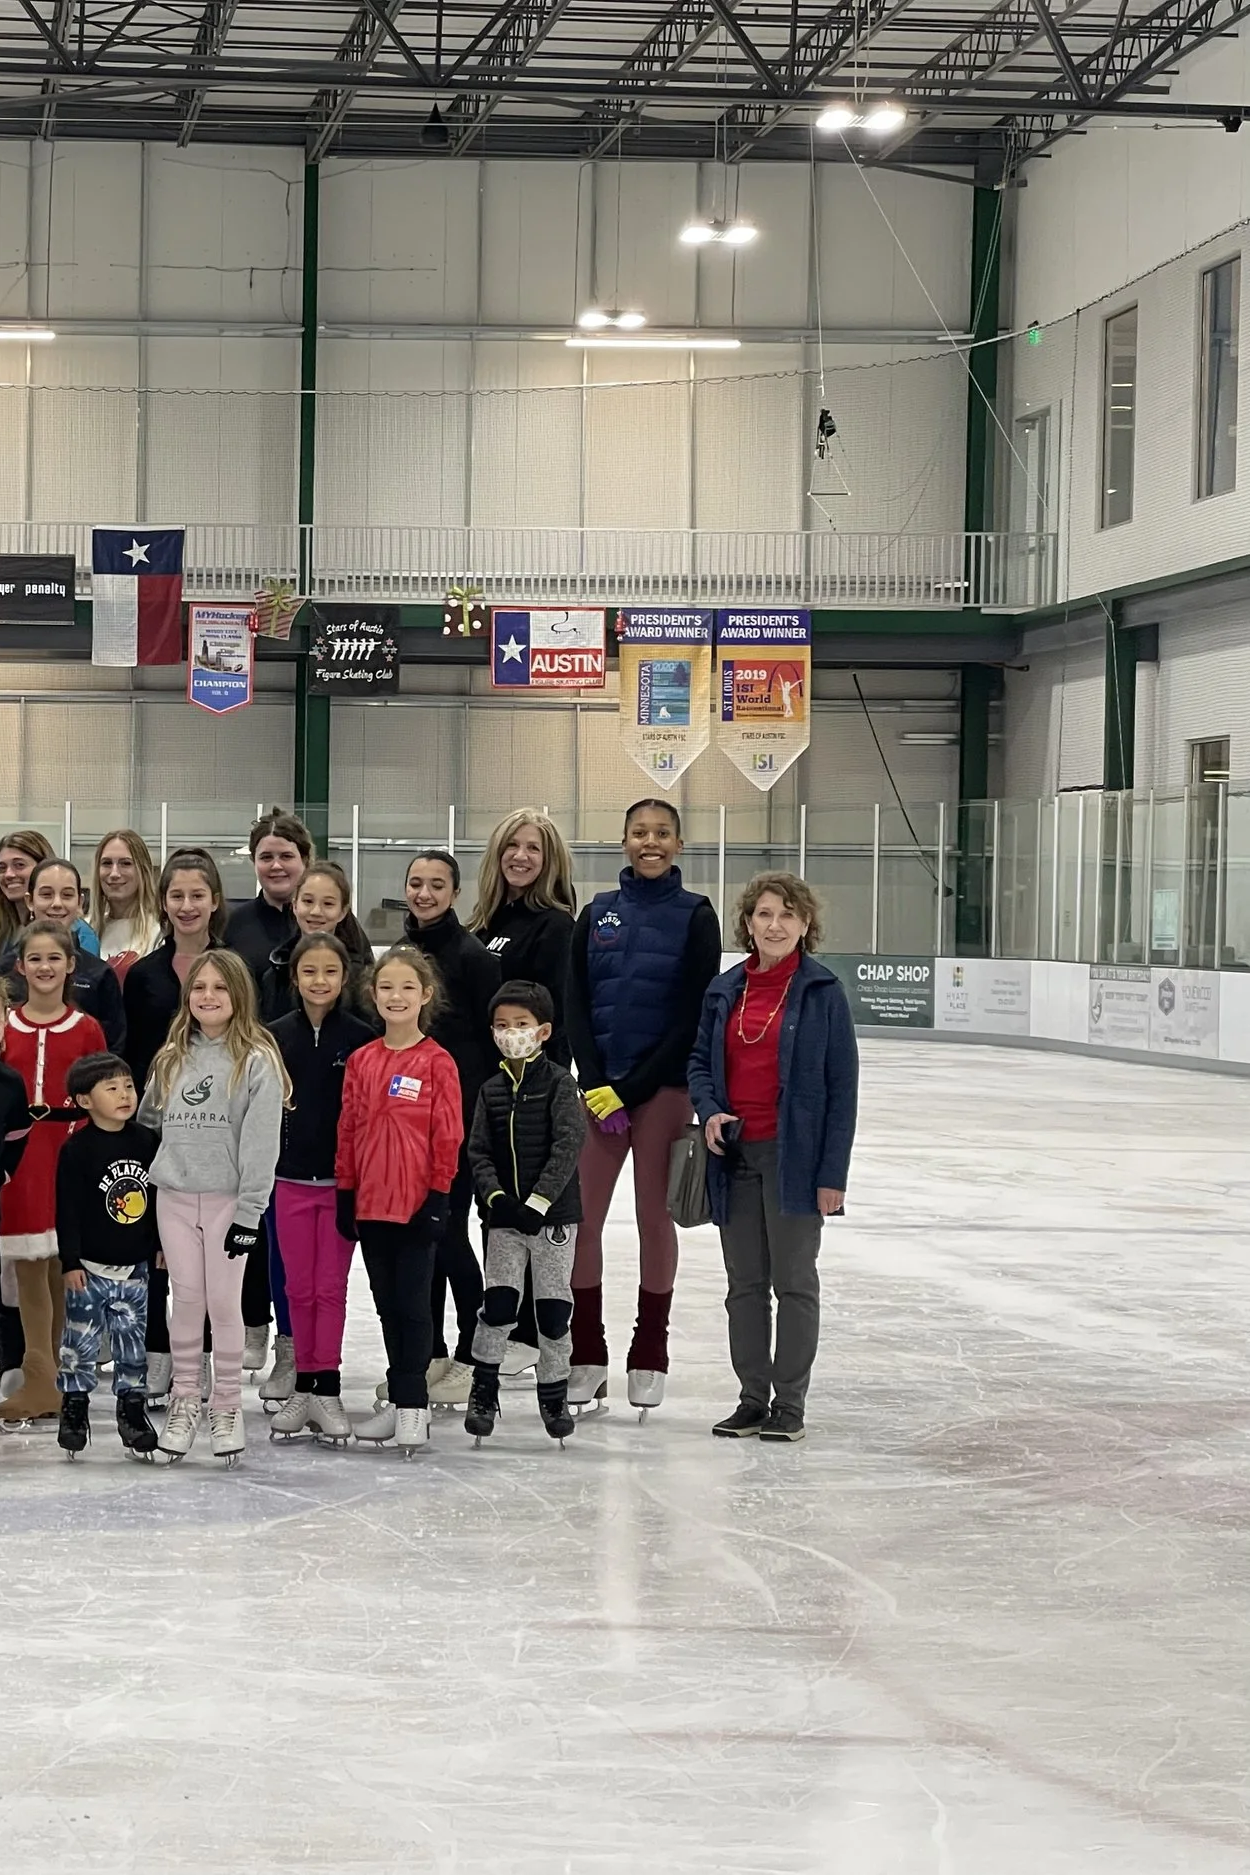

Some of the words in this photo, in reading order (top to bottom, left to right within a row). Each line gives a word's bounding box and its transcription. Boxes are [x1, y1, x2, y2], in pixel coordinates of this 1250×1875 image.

[25, 582, 66, 597] penalty
[631, 614, 702, 626] PRESIDENT'S
[728, 615, 799, 627] PRESIDENT'S
[326, 624, 347, 635] Stars
[349, 620, 360, 632] of
[360, 622, 384, 635] Austin
[624, 627, 663, 638] AWARD
[665, 627, 708, 638] WINNER
[720, 628, 761, 639] AWARD
[762, 628, 807, 639] WINNER
[531, 654, 602, 673] AUSTIN
[316, 668, 341, 682] Figure
[342, 668, 374, 682] Skating
[375, 668, 394, 679] Club
[735, 670, 767, 680] 2019
[194, 680, 246, 688] CHAMPION
[736, 684, 754, 693] ISI
[641, 665, 651, 724] MINNESOTA
[736, 695, 771, 704] World
[654, 753, 673, 769] ISI
[753, 754, 773, 769] ISI
[598, 916, 622, 927] AUSTIN
[857, 964, 894, 981] CHAP
[896, 966, 930, 982] SHOP
[946, 992, 969, 1000] HYATT
[950, 1002, 966, 1010] PLACE
[99, 1175, 114, 1192] BE
